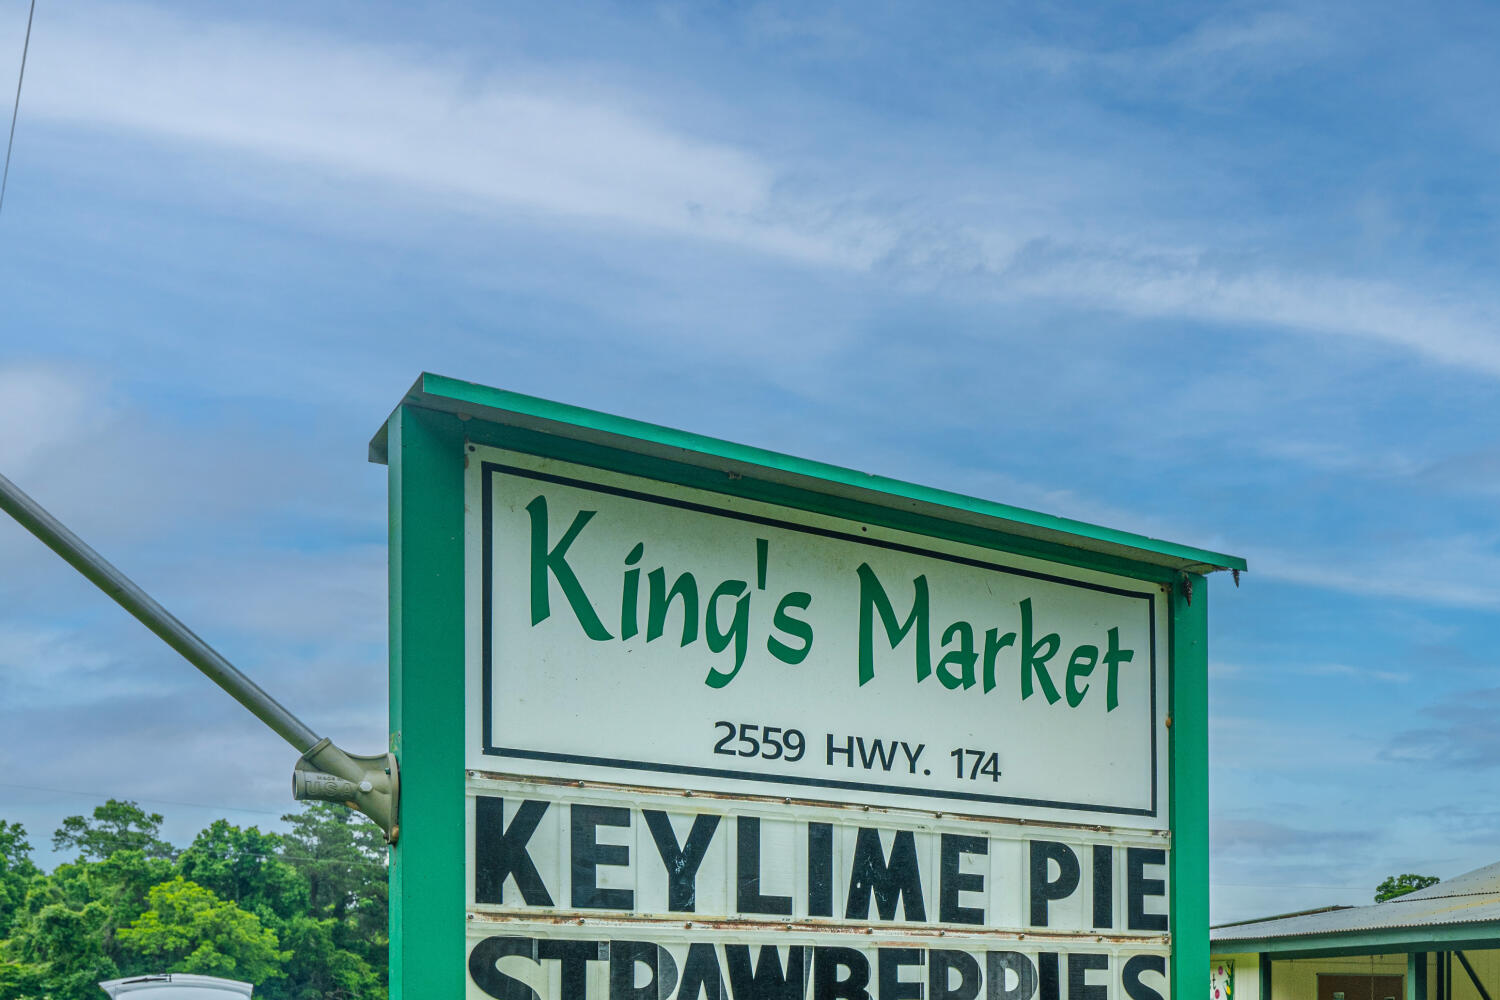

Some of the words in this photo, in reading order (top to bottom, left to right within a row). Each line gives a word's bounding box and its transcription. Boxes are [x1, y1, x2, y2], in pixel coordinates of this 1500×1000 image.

[525, 494, 814, 689] King's
[857, 561, 1135, 713] Market
[713, 720, 806, 763] 2559
[825, 732, 932, 777] HWY.
[950, 747, 1002, 783] 174
[475, 795, 989, 926] KEYLIME
[1029, 839, 1169, 932] PIE
